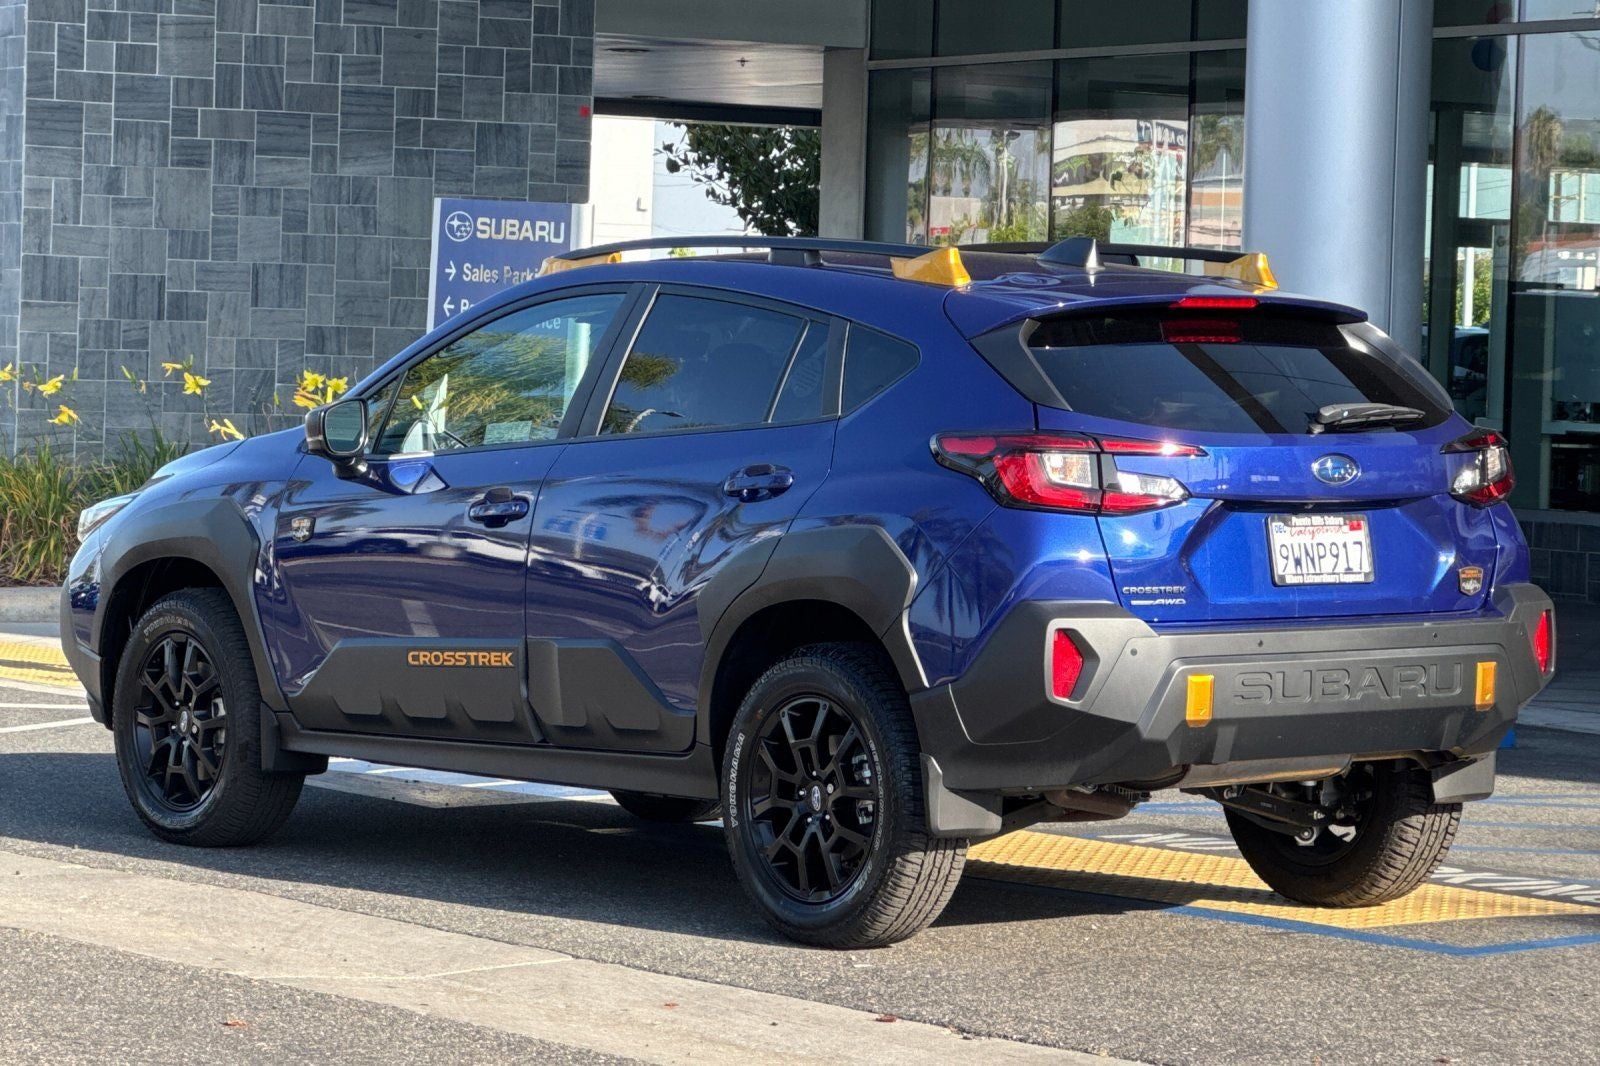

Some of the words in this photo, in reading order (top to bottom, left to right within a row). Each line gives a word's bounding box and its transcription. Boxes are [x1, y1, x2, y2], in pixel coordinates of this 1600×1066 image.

[476, 216, 565, 244] SUBARU
[463, 262, 499, 283] Sales
[1279, 541, 1363, 573] 9WNP917
[1122, 586, 1187, 594] CROSSTREK
[407, 651, 514, 667] CROSSTREK
[1234, 662, 1463, 705] SUBARU
